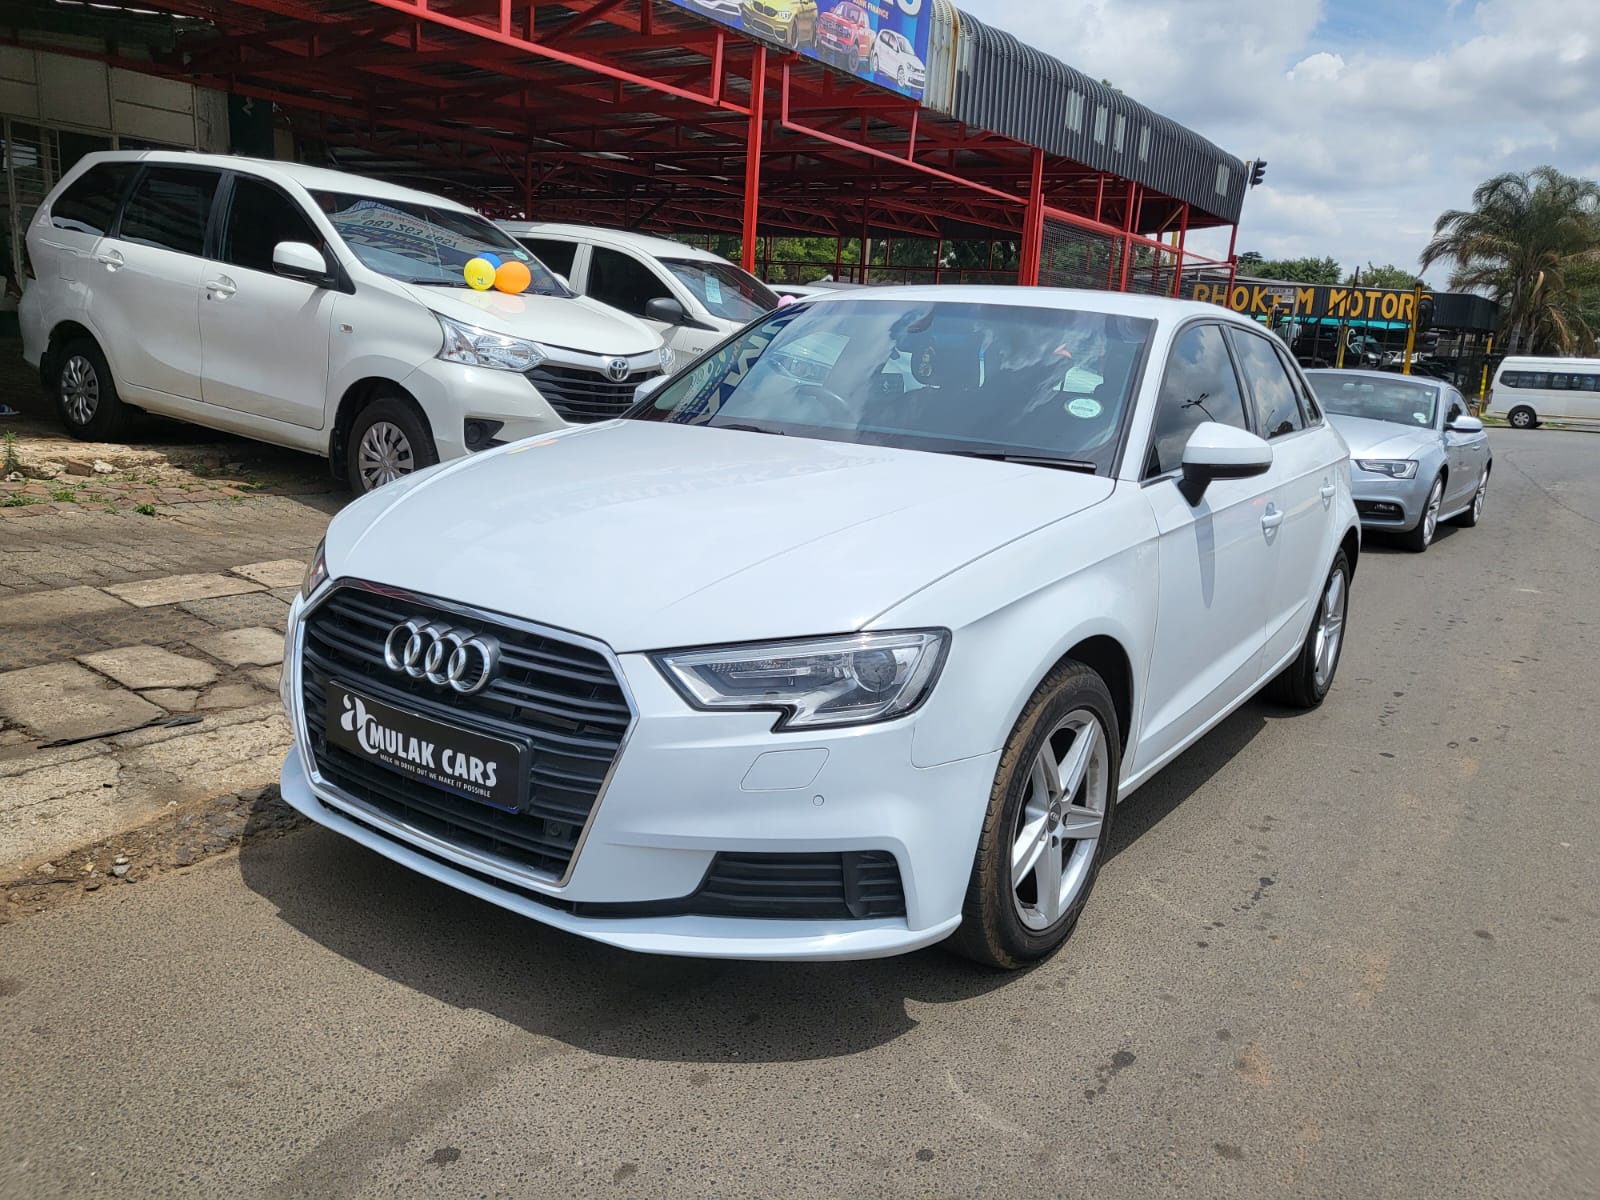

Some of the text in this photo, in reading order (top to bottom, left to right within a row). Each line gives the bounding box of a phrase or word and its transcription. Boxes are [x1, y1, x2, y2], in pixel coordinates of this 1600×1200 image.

[1328, 288, 1433, 321] MOTOR
[400, 761, 415, 773] DRIVE
[416, 767, 428, 777] OUT
[429, 771, 438, 780] WE
[438, 775, 454, 786] MAKE
[456, 781, 462, 789] IT
[463, 783, 491, 798] POSSIBLE
[441, 748, 497, 787] CARS
